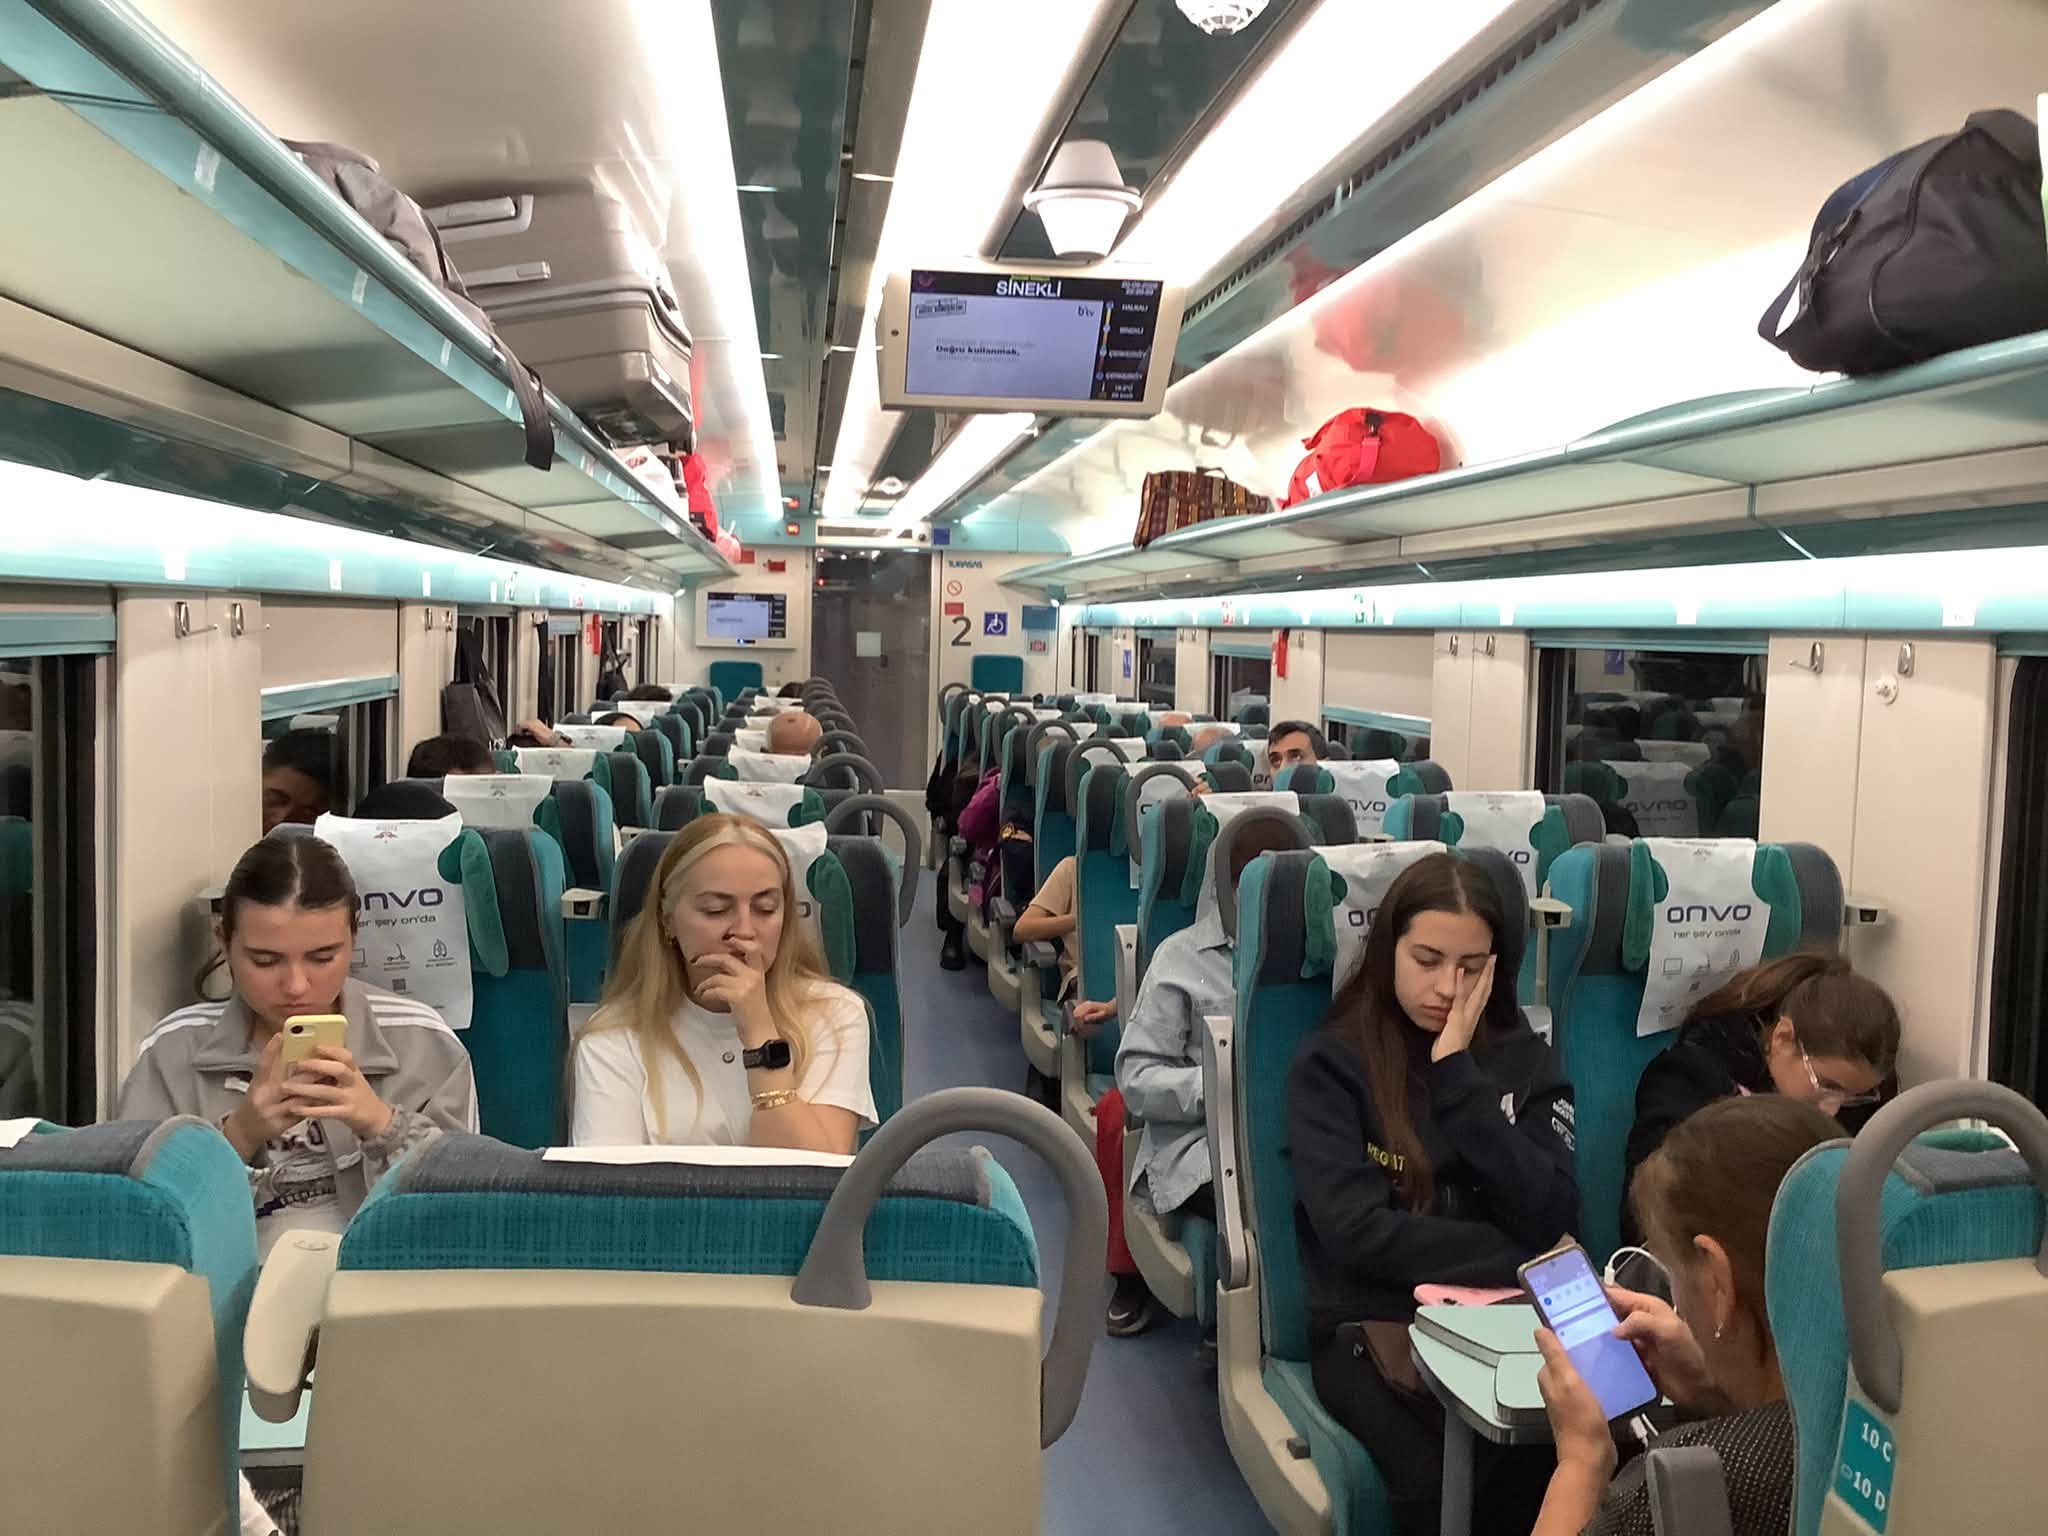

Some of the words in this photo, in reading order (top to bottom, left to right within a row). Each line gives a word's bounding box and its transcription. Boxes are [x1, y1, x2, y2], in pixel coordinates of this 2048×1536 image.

[951, 616, 972, 646] 2
[1348, 800, 1387, 812] nvo
[359, 888, 444, 911] nvo
[1667, 905, 1752, 923] onvo
[1861, 1422, 1880, 1449] 10
[1882, 1441, 1893, 1462] C
[1853, 1471, 1872, 1499] 10
[1874, 1490, 1886, 1511] D
